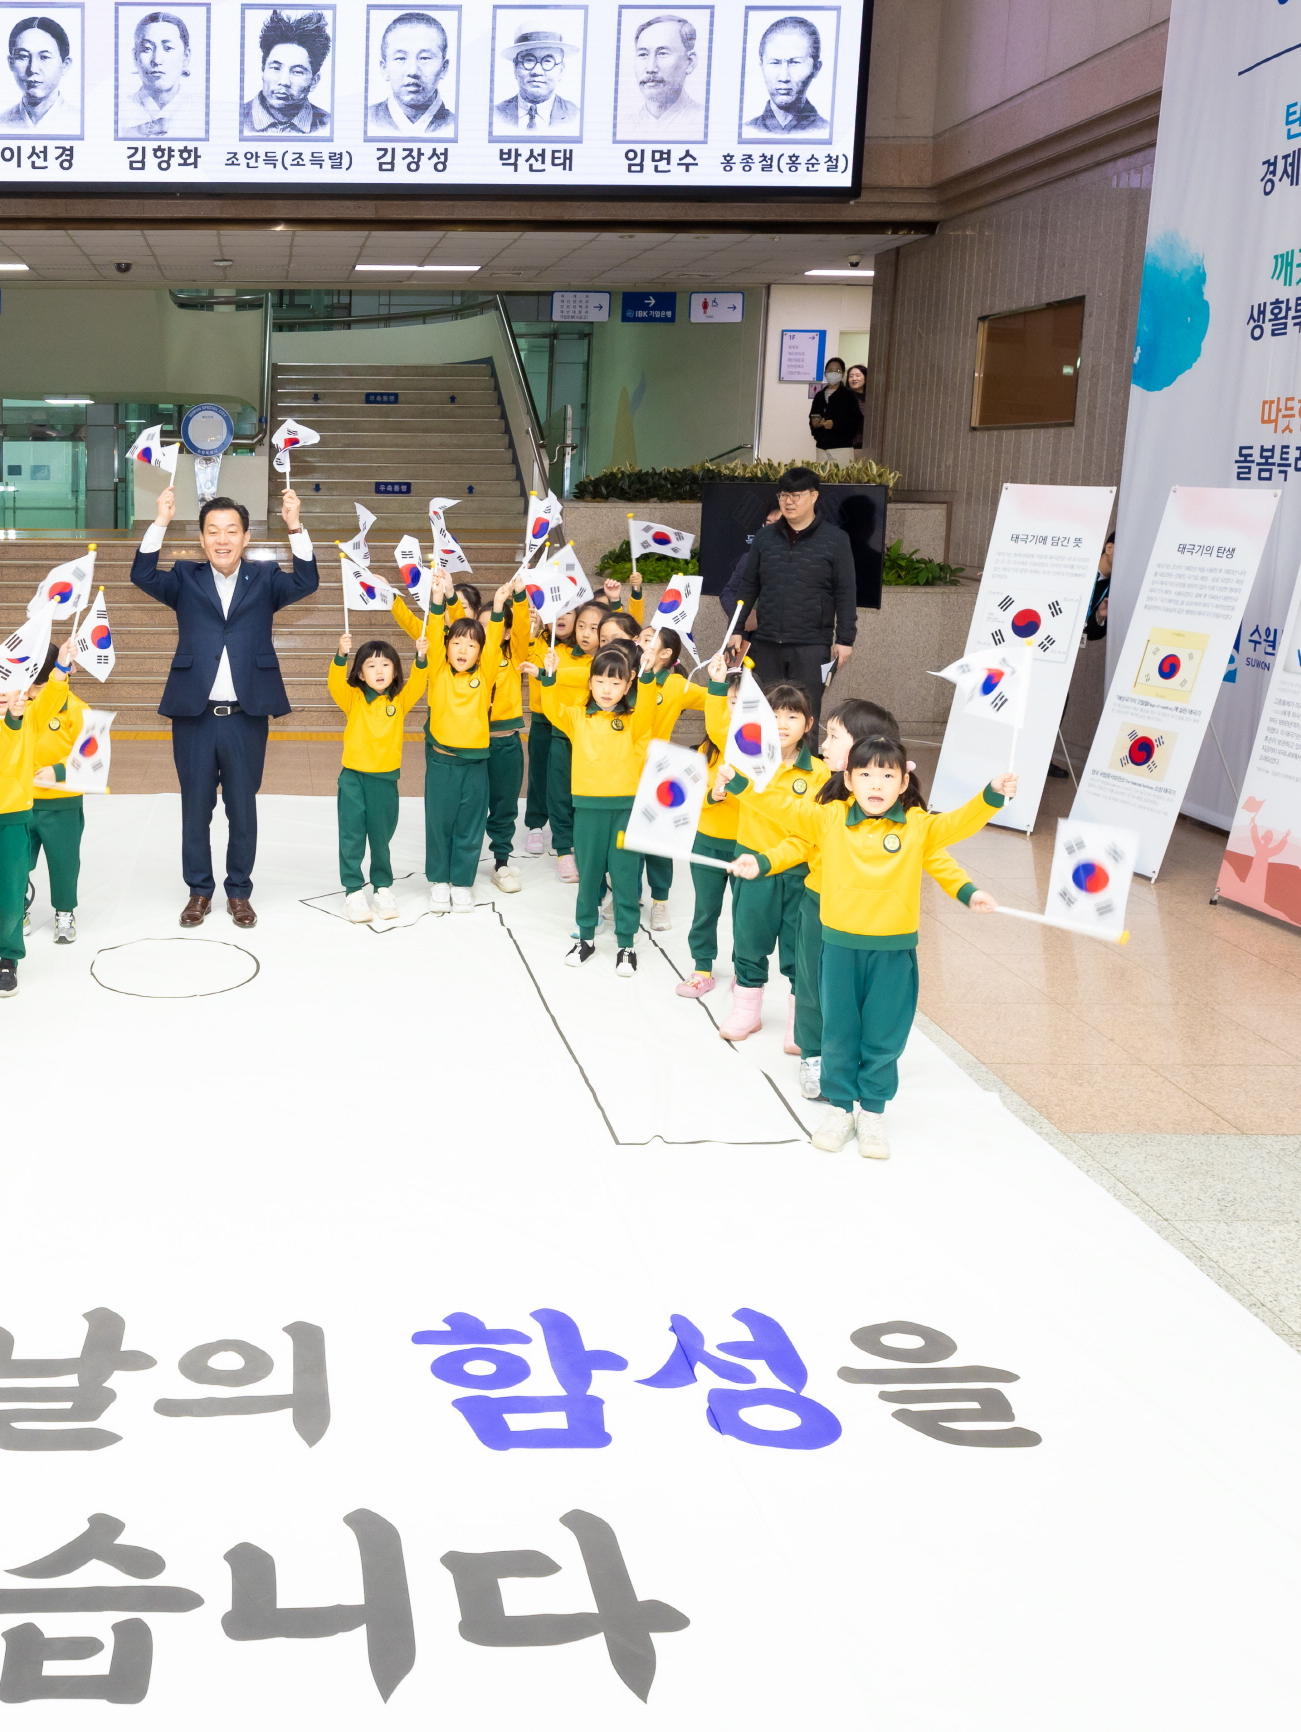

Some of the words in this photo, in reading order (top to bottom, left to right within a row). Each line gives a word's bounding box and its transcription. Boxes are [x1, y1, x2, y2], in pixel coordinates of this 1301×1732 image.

[1, 146, 73, 170] 이선경
[127, 145, 201, 171] 김향화
[225, 151, 352, 171] 조안득(조득렬)
[377, 148, 448, 172] 김장성
[500, 149, 572, 172] 박선태
[625, 149, 698, 173] 임면수
[720, 153, 850, 173] 홍종철(홍순철)
[650, 310, 671, 318] 기업은행
[1011, 533, 1048, 546] 태극기에
[1051, 536, 1070, 548] 담긴
[1073, 537, 1083, 548] 뜻
[1177, 543, 1214, 557] 태극기의
[1216, 546, 1236, 559] 탄생
[411, 1308, 1042, 1451] 함성을
